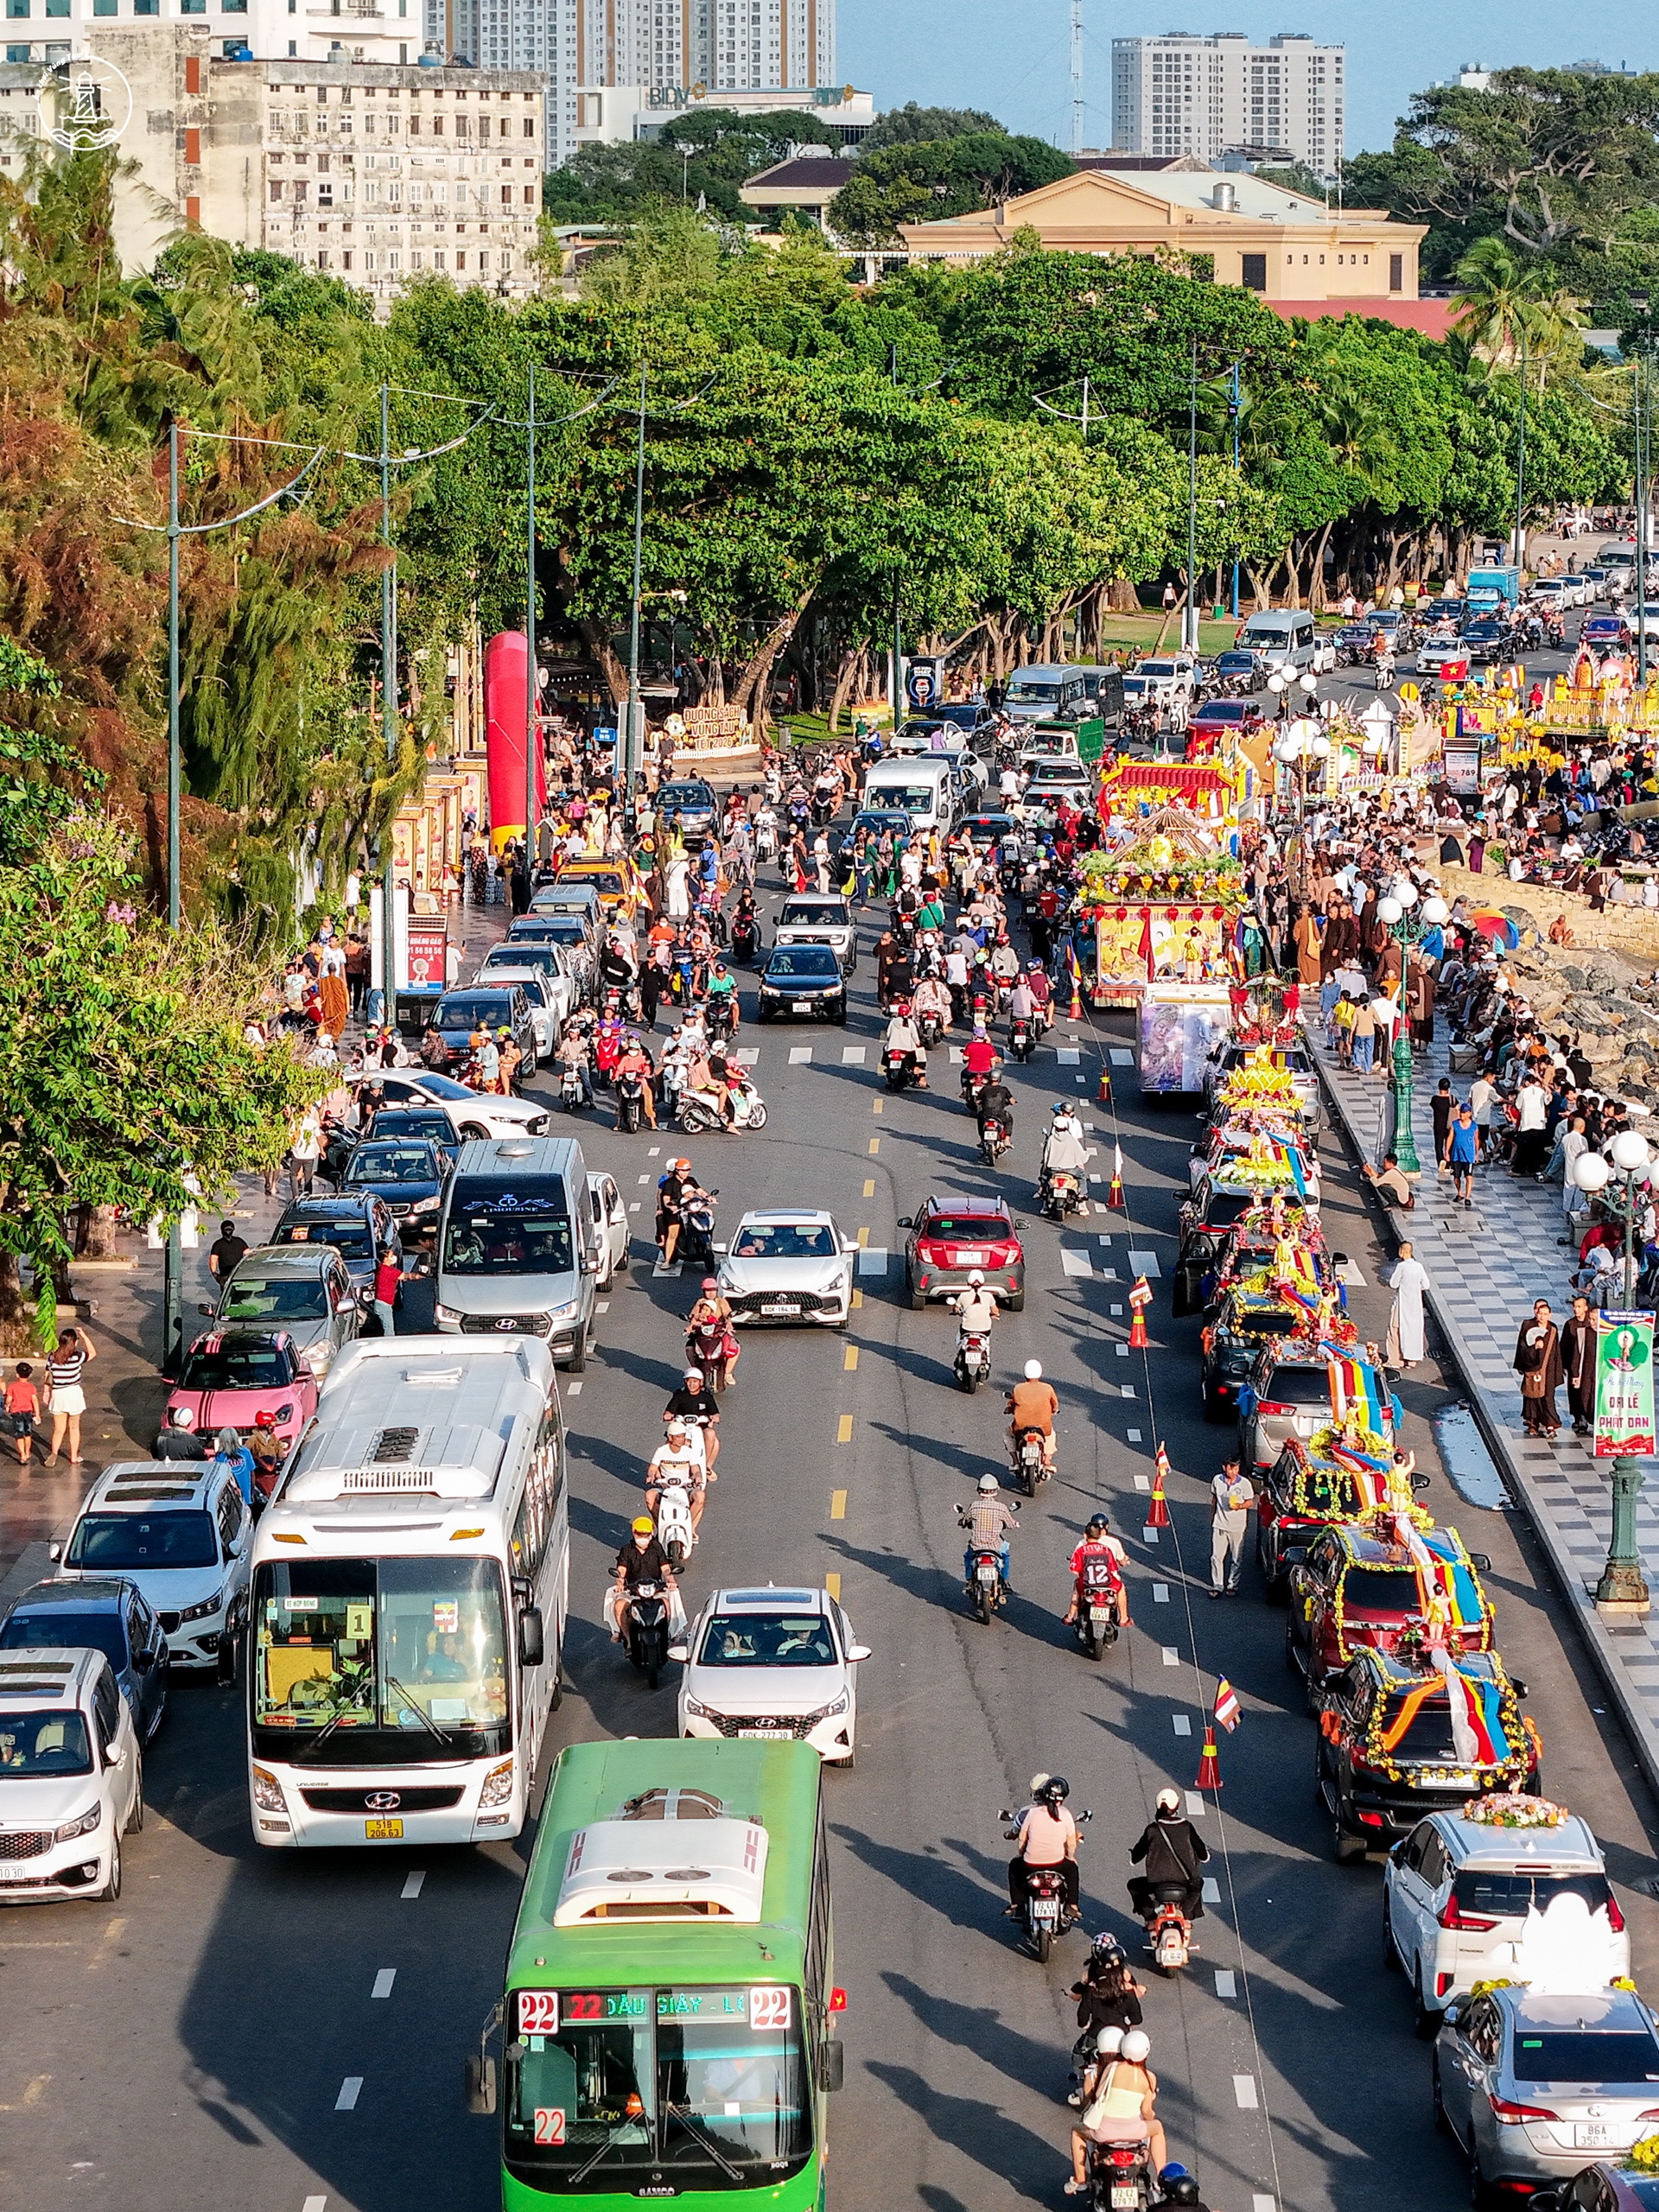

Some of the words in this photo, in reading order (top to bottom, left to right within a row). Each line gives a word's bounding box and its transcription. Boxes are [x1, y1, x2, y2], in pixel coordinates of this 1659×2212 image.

[650, 87, 690, 105] BIDV
[719, 703, 740, 719] SÁCH
[692, 721, 717, 735] VŨNG
[721, 720, 734, 733] TÀU
[696, 735, 709, 750] TẾT
[713, 738, 733, 748] 2026
[410, 935, 429, 945] QUẢNG
[430, 936, 442, 944] CÁO
[499, 1198, 518, 1206] CD
[1628, 1392, 1639, 1408] LỄ
[1087, 1565, 1109, 1585] 12
[354, 1614, 365, 1632] 1
[370, 1828, 399, 1838] 206.63
[376, 1821, 392, 1829] 51B
[522, 1995, 556, 2031] 22
[569, 1994, 602, 2019] 22
[753, 1990, 788, 2027] 22
[536, 2111, 563, 2142] 22
[1588, 2126, 1606, 2135] 86A
